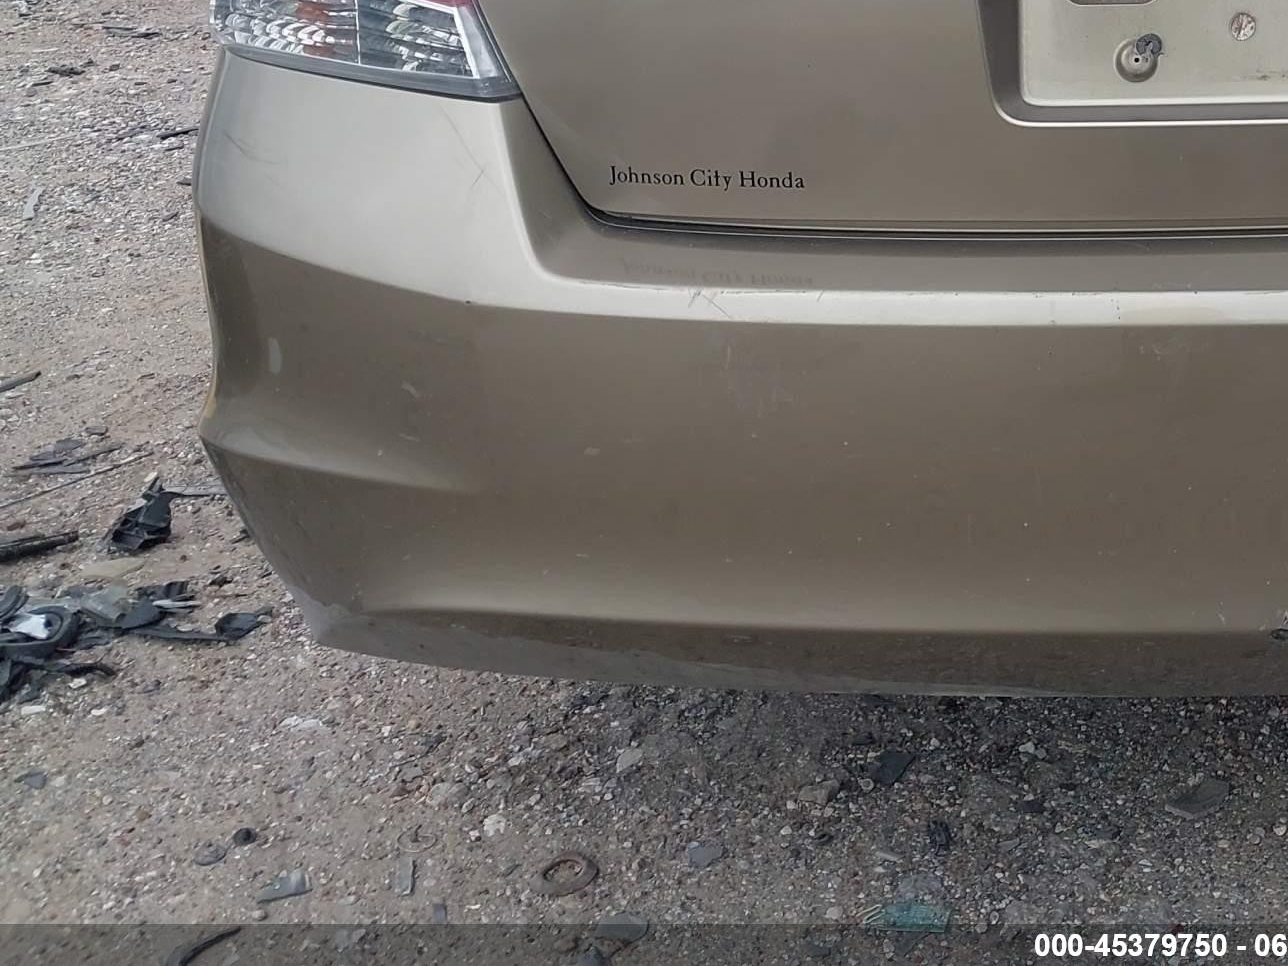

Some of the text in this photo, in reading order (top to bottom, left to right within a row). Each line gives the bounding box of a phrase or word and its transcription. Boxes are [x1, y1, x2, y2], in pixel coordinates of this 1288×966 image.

[609, 165, 805, 191] Johnson City Honda
